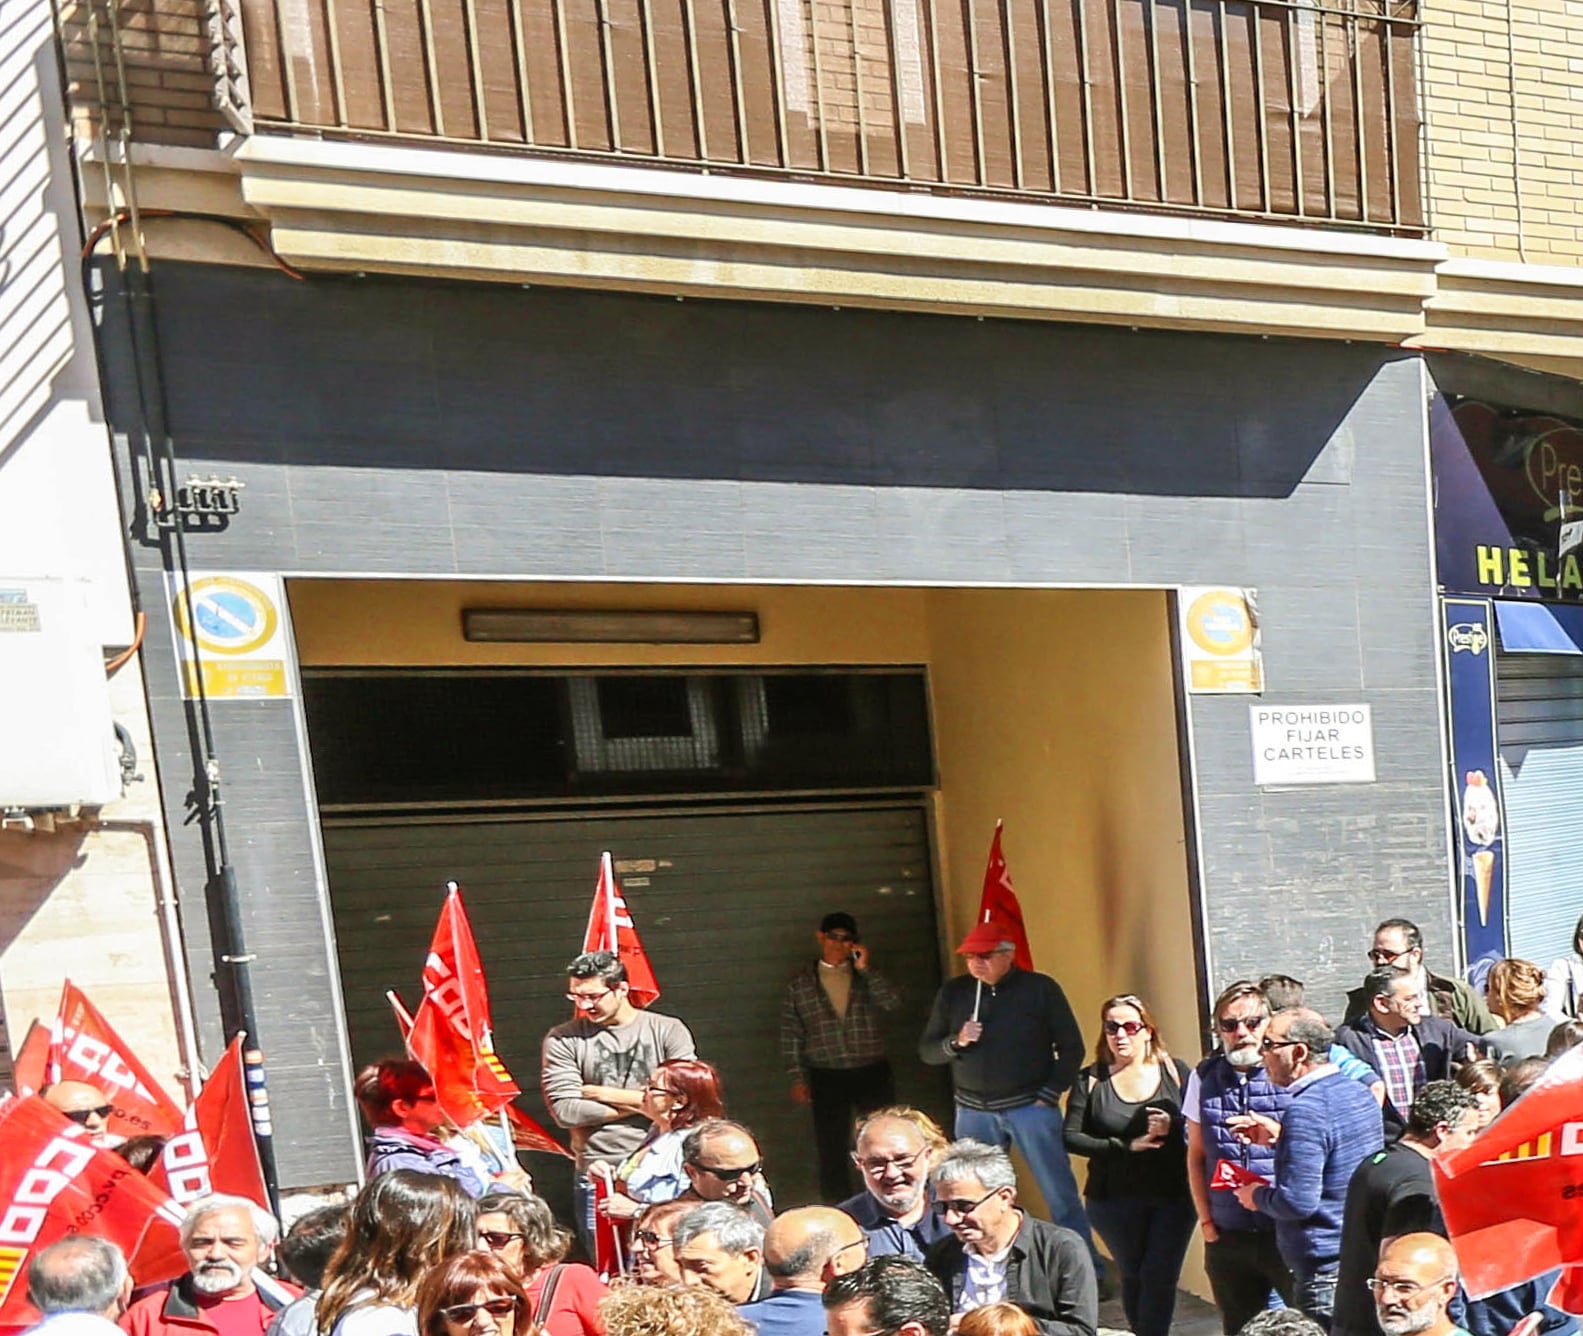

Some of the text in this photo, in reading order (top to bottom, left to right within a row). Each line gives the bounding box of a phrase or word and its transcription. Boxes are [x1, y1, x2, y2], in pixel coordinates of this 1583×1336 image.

[1259, 711, 1365, 726] PROHIBIDO
[1286, 729, 1340, 743] FIJAR
[1264, 746, 1365, 761] CARTELES
